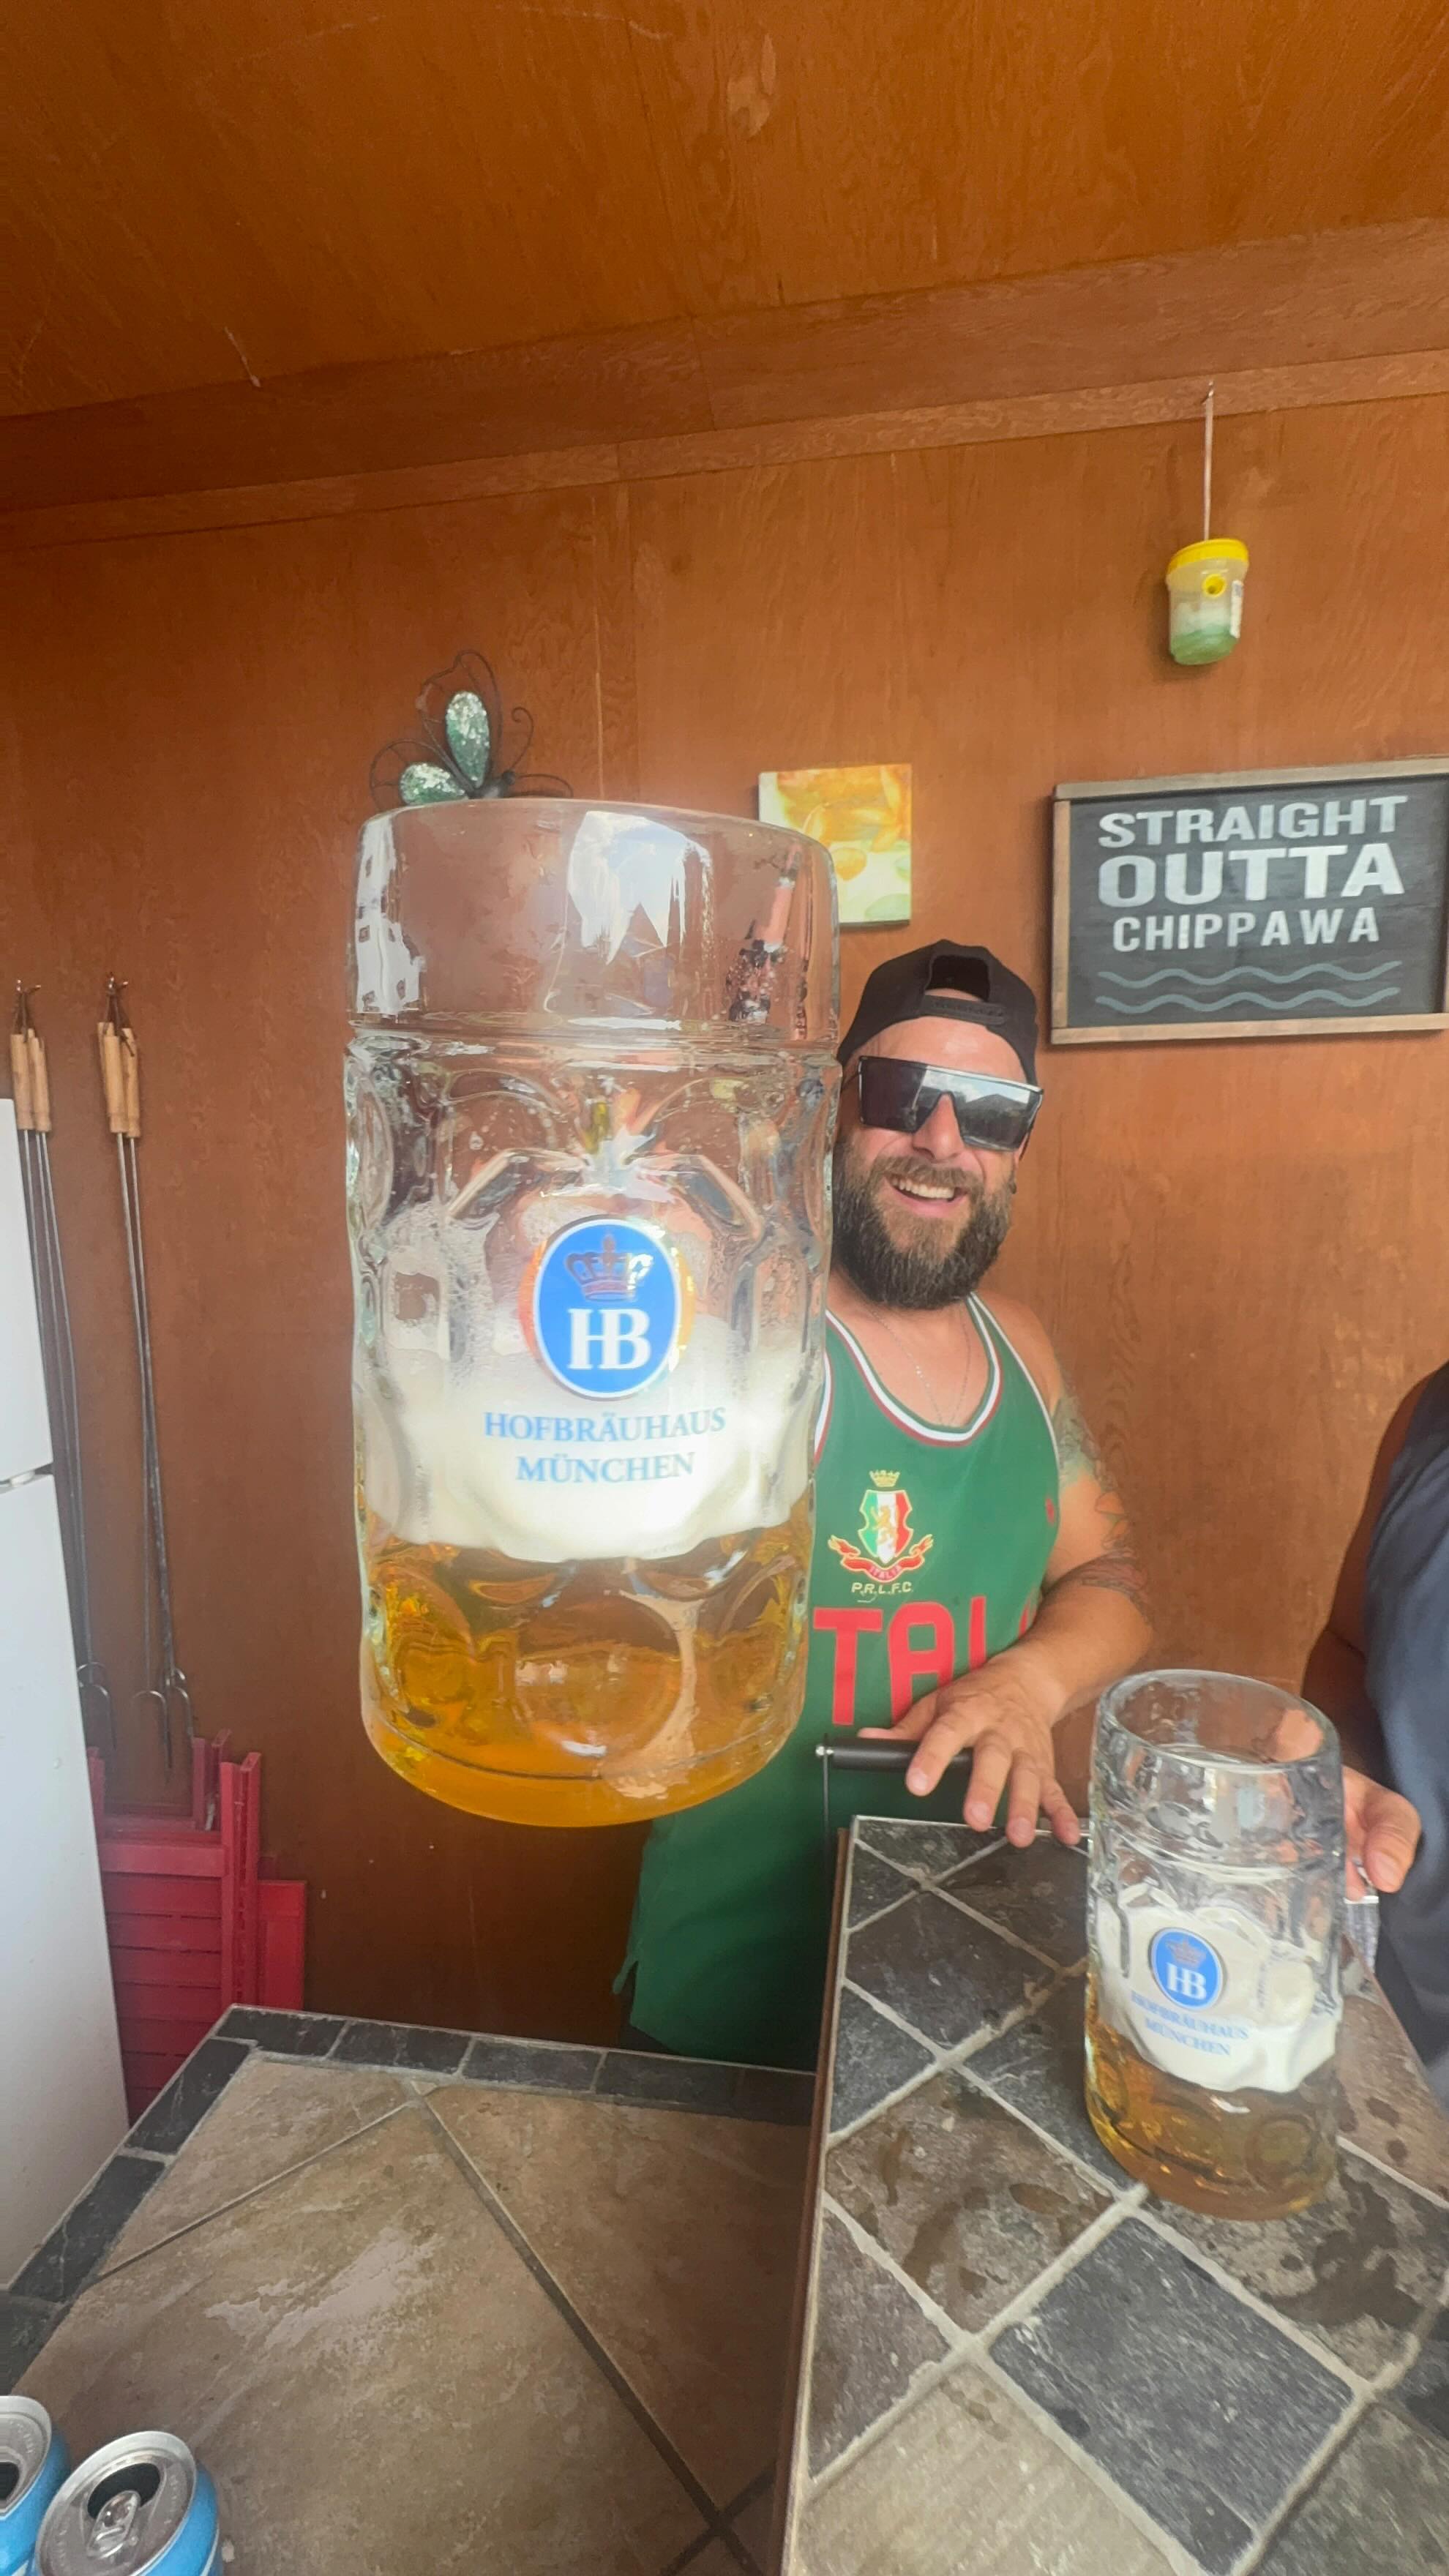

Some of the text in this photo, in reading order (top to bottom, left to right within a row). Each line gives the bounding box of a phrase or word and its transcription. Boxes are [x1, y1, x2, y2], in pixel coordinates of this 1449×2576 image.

[1098, 795, 1408, 848] STRAIGHT
[1098, 842, 1404, 908] OUTTA
[1112, 907, 1380, 952] CHIPPAWA
[568, 1308, 651, 1369] HB
[484, 1407, 726, 1442] HOFBRÄUHAUS
[517, 1453, 694, 1483] MÜNCHEN
[1167, 1963, 1207, 1999] HB
